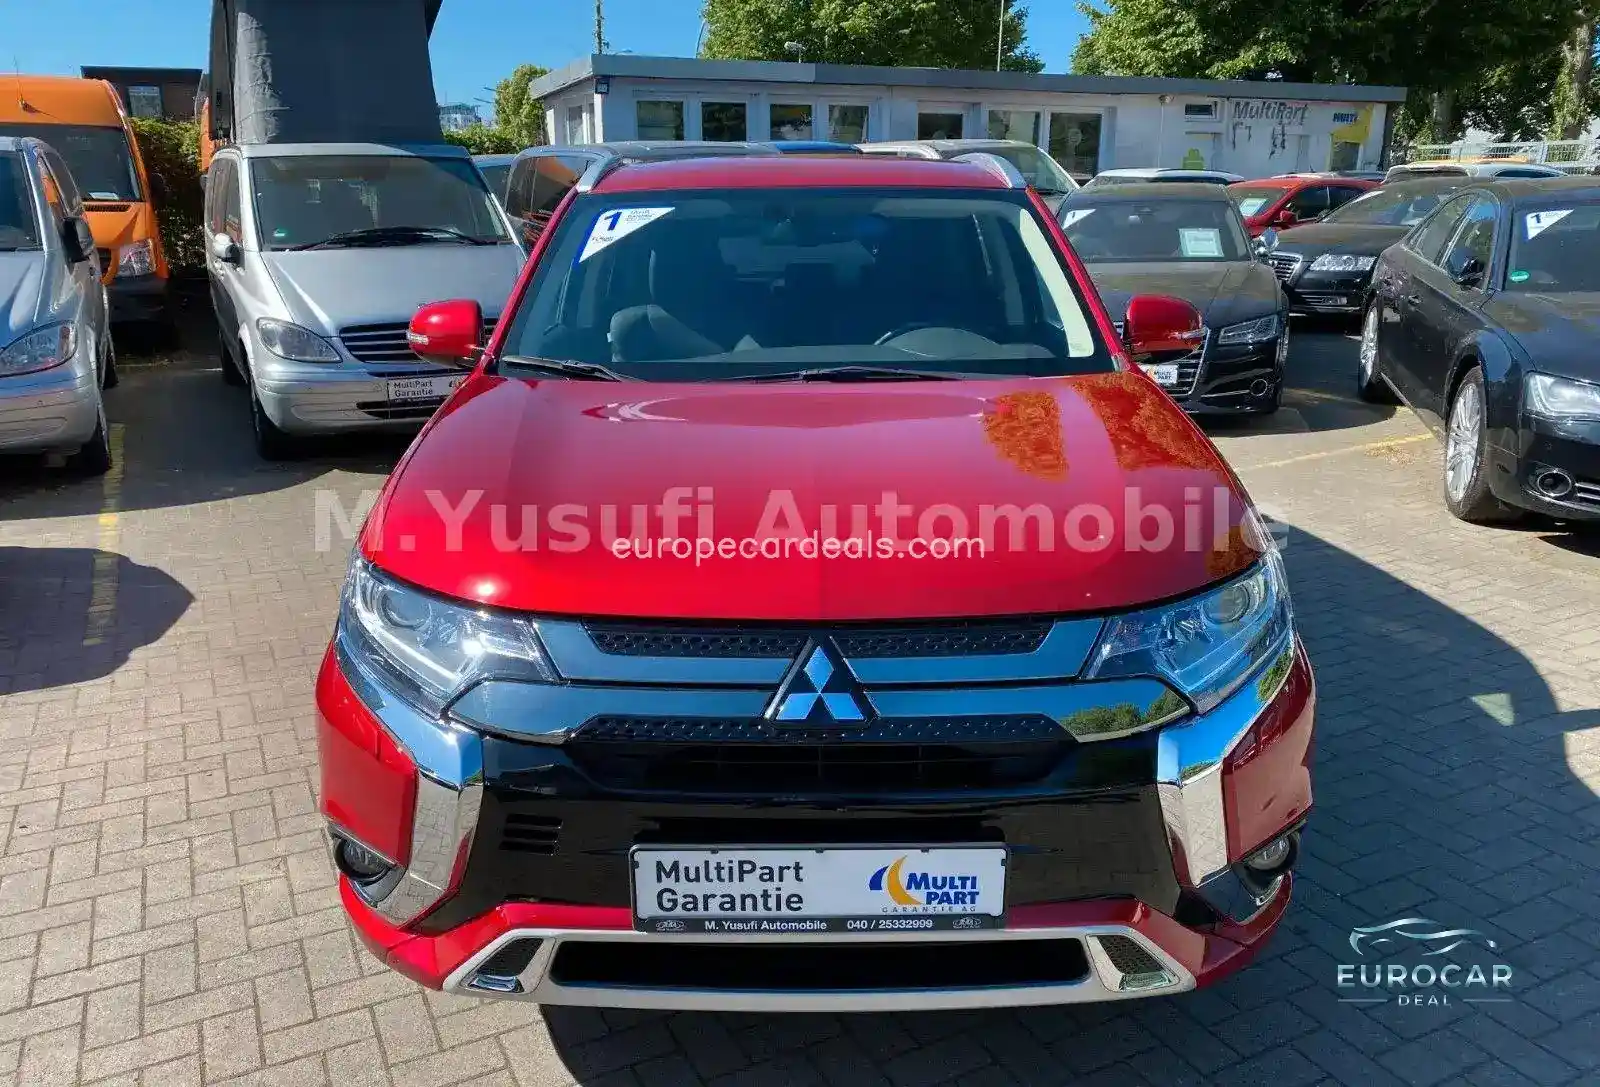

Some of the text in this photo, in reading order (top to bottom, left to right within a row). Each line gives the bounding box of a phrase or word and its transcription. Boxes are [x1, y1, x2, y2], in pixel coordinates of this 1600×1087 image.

[604, 211, 622, 231] 1
[1530, 212, 1542, 223] 1
[393, 380, 433, 389] MultiPart
[395, 388, 433, 397] Garantie
[656, 859, 804, 884] MultiPart
[906, 873, 977, 890] MULTI
[656, 887, 804, 912] Garantie
[925, 890, 980, 906] PART
[705, 921, 720, 931] M.
[722, 920, 757, 931] Yusufi
[760, 920, 828, 931] Automobile
[847, 920, 868, 930] 040
[878, 919, 933, 930] 25332999
